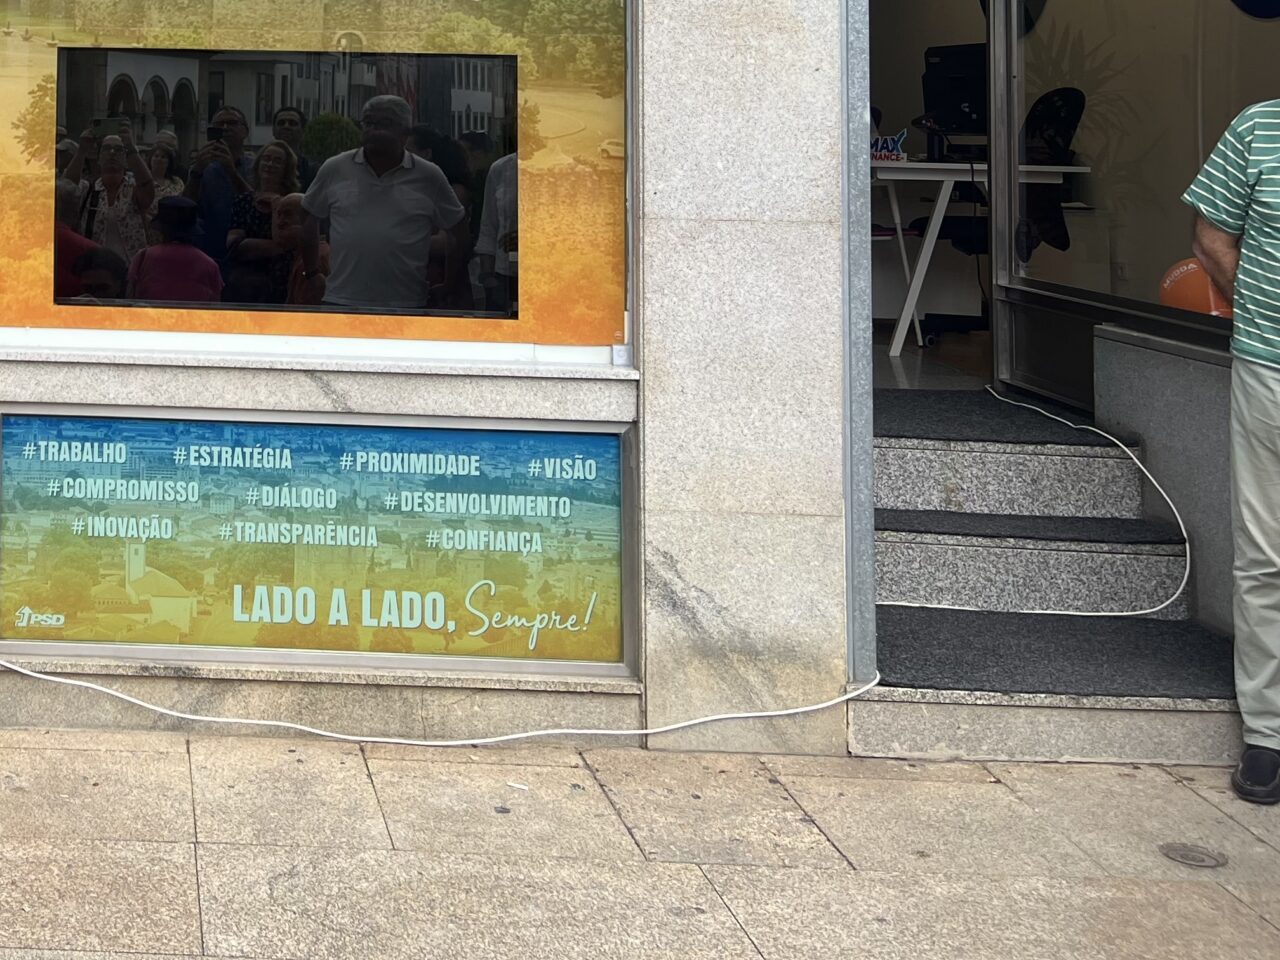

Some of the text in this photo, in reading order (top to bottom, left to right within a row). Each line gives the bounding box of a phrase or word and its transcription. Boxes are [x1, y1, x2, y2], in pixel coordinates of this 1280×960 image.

[22, 441, 597, 480] #TRABALHO #ESTRATÉGIA #PROXIMIDADE #VISÃO
[47, 477, 570, 518] #COMPROMISSO #DIÁLOGO #DESENVOLVIMENTO
[71, 514, 542, 556] #INOVAÇÃO #TRANSPARÊNCIA #CONFIANÇA
[30, 614, 65, 625] PSD
[232, 579, 597, 650] LADO A LADO, Sempre!
